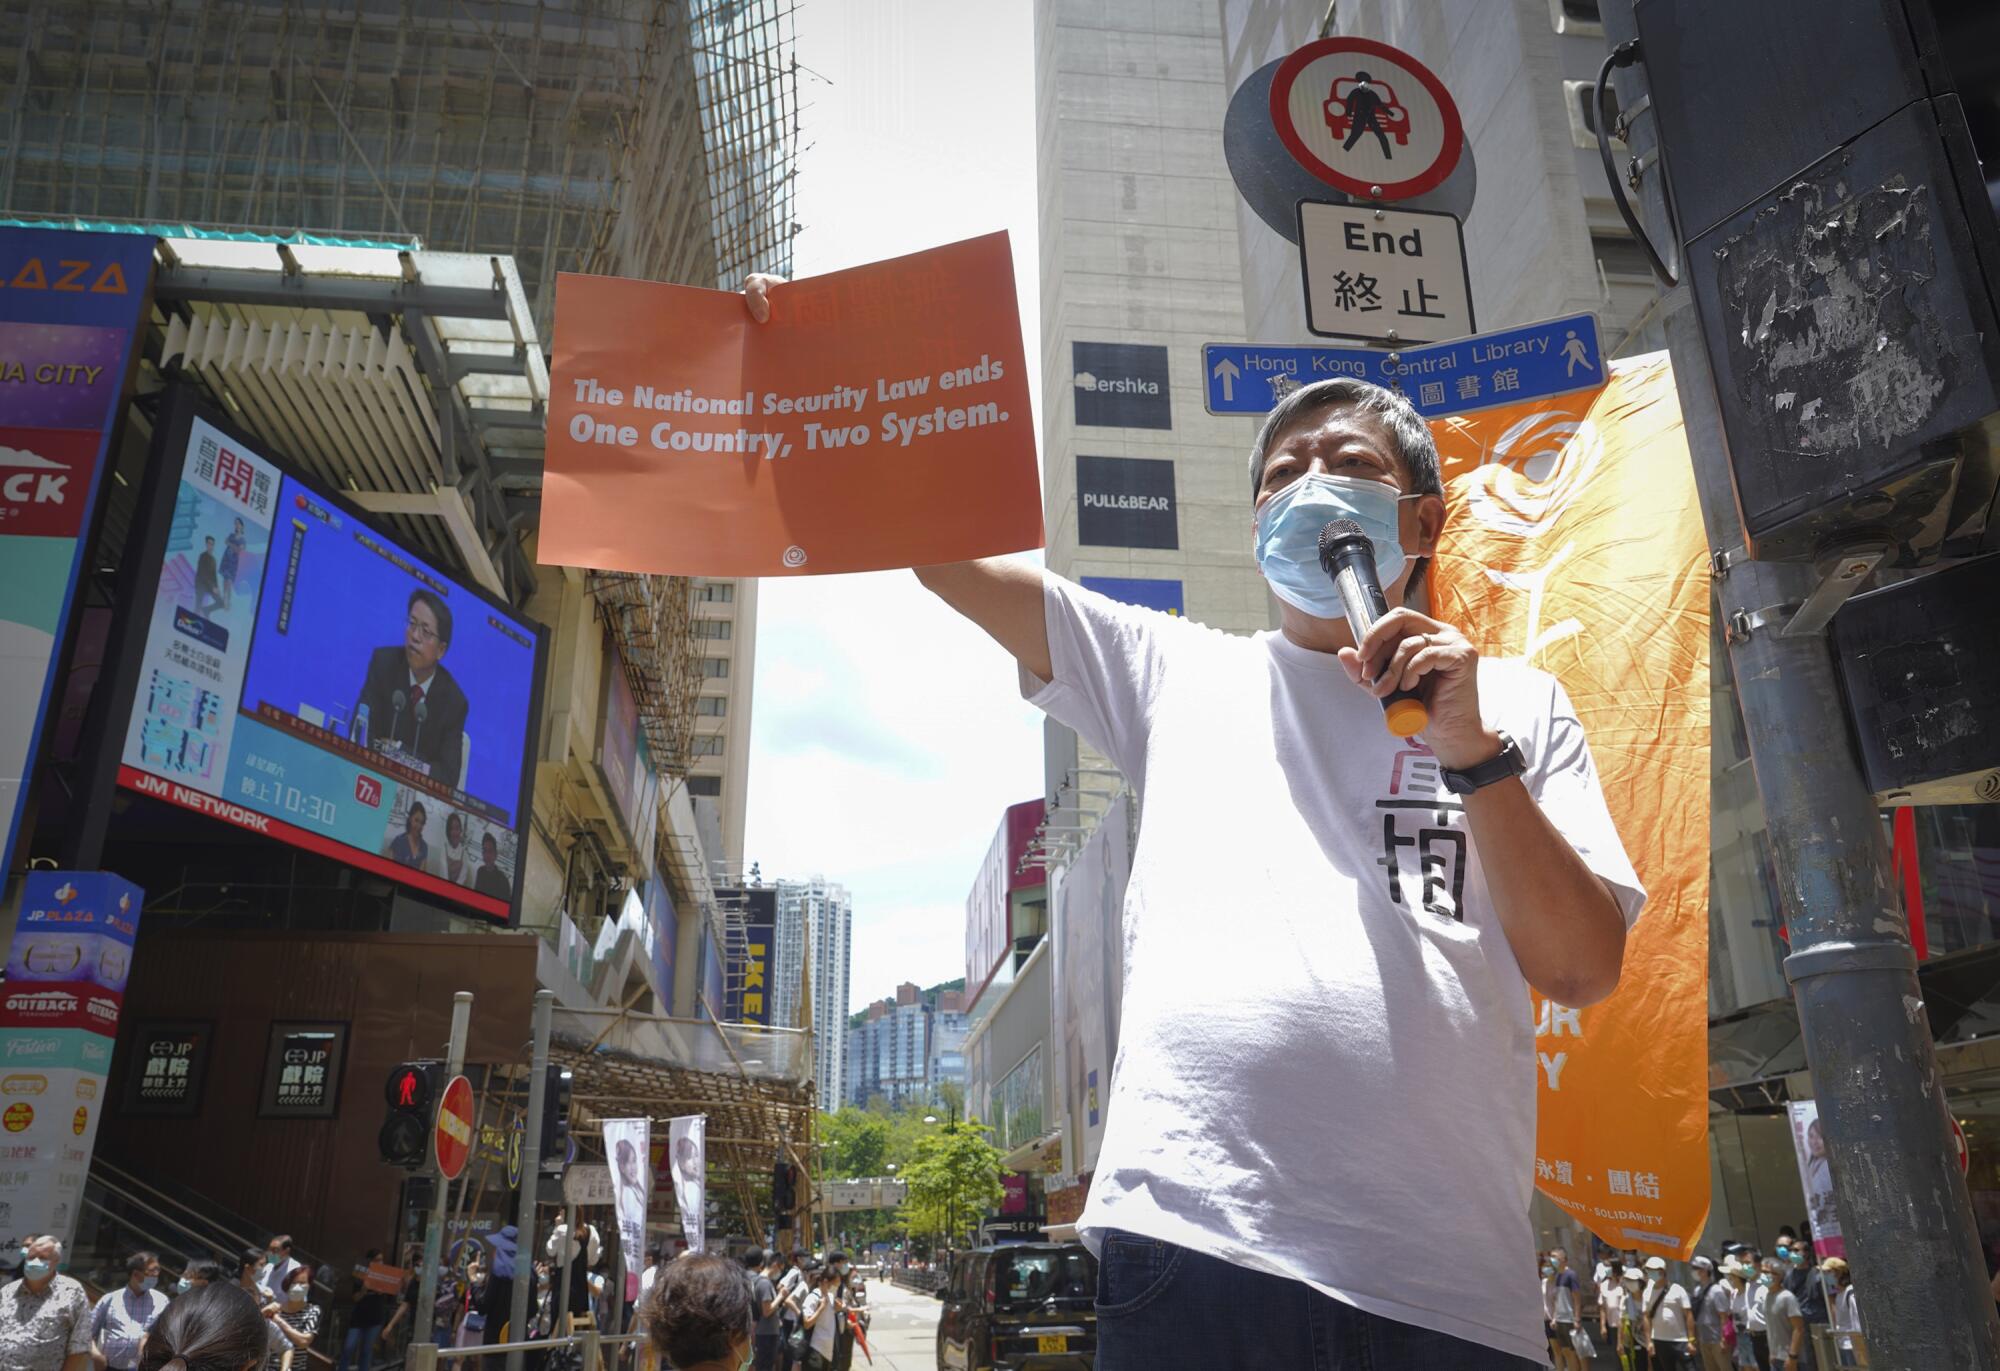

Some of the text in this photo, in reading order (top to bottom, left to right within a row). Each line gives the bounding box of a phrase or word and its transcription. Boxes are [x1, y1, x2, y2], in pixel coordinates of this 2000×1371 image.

[1343, 222, 1423, 257] End
[0, 257, 128, 293] AZA
[1332, 269, 1446, 319] 終止
[1244, 336, 1550, 377] Hong Kong Central Library
[35, 363, 103, 385] CITY
[574, 354, 1004, 416] The National Security Law ends
[570, 402, 1010, 460] One Country, Two System.
[213, 447, 254, 504] 開
[1083, 493, 1169, 511] PULL&BEAR
[135, 774, 270, 832] JM NETWORK
[27, 910, 95, 922] JP PLAZA
[5, 999, 78, 1011] OUTBACK
[742, 943, 766, 1044] IKEA
[87, 1002, 119, 1021] OUTBACK
[173, 1043, 192, 1056] JP
[308, 1050, 327, 1064] JP
[145, 1057, 190, 1077] 戲院
[280, 1065, 325, 1085] 戲院
[1537, 1051, 1568, 1091] Y
[1607, 1168, 1660, 1200] 團結
[1594, 1207, 1663, 1226] SOLIDARITY
